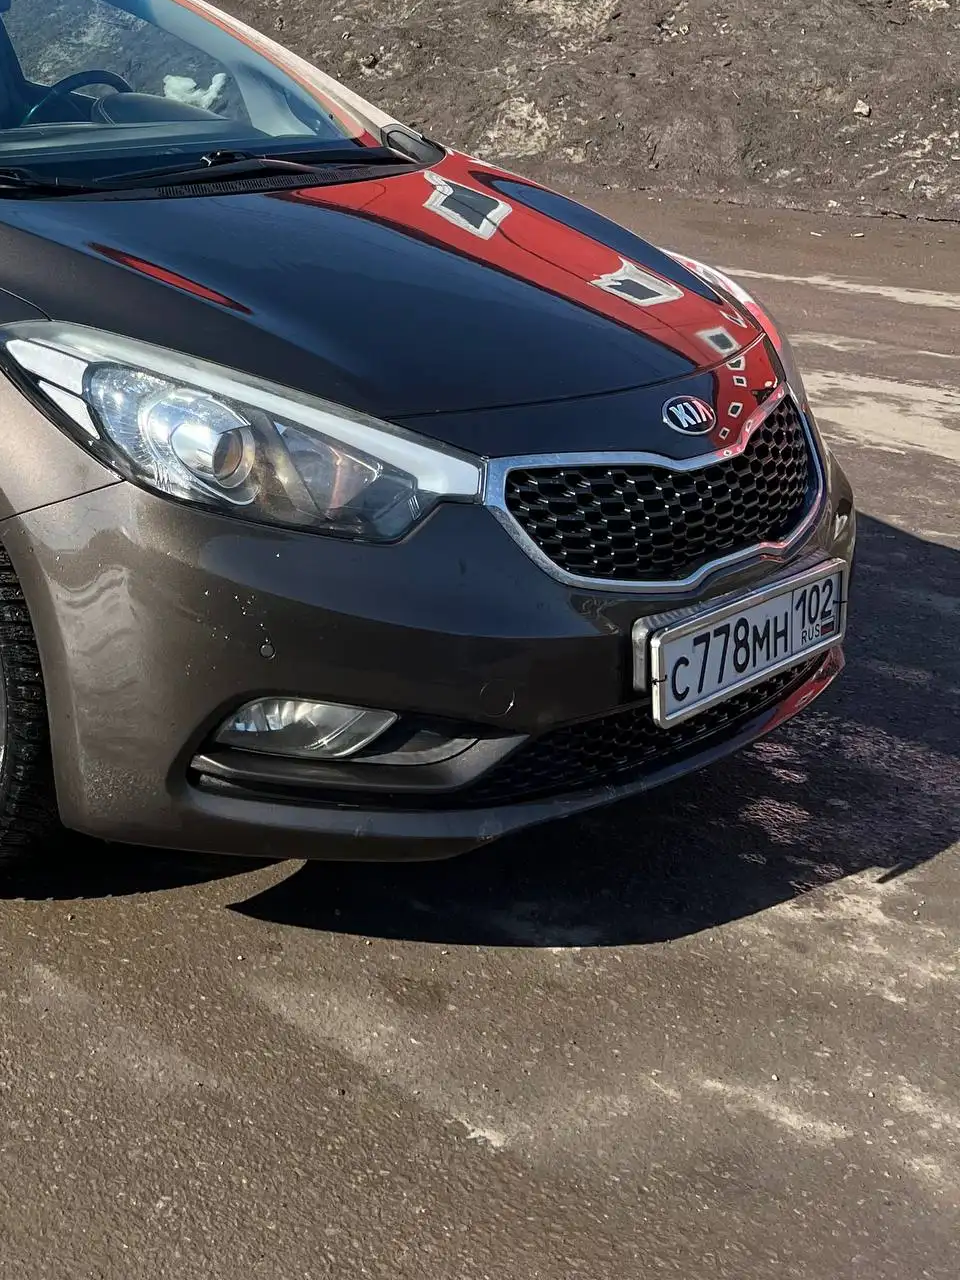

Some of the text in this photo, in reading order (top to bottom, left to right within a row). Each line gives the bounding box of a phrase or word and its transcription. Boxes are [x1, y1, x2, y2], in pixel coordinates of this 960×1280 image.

[669, 400, 713, 428] KIA
[671, 578, 833, 701] С778МН 102
[801, 623, 820, 645] RUS
